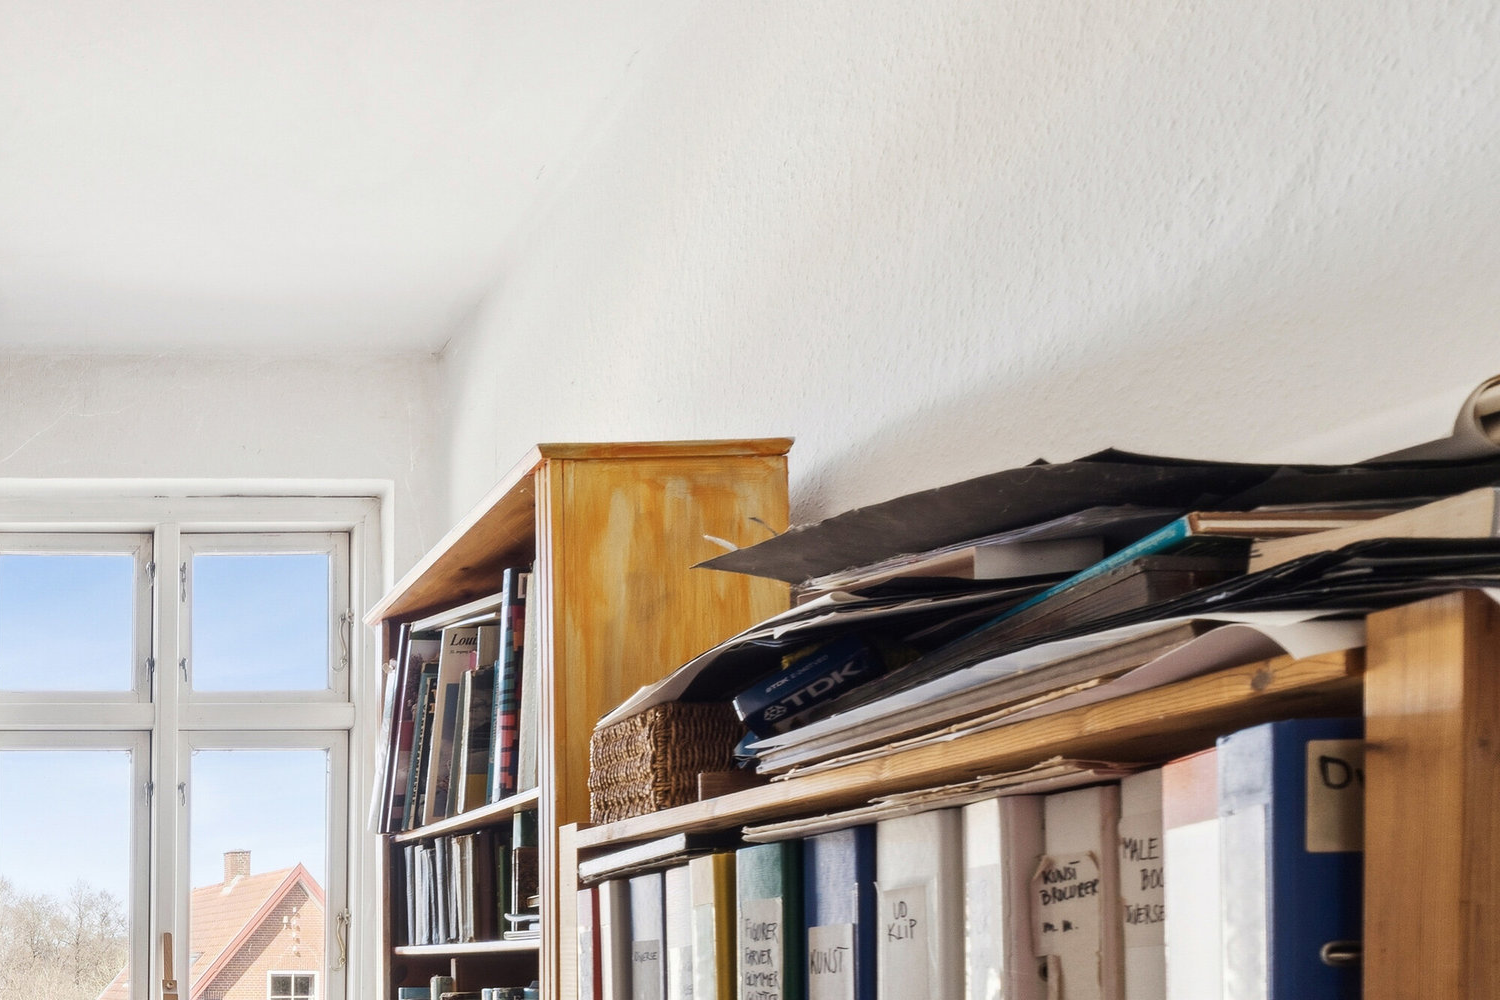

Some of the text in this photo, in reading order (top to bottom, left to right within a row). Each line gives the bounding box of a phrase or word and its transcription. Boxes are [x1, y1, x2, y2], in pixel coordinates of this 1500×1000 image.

[781, 661, 861, 707] TDK
[893, 901, 908, 920] UD
[810, 946, 850, 975] KUNST
